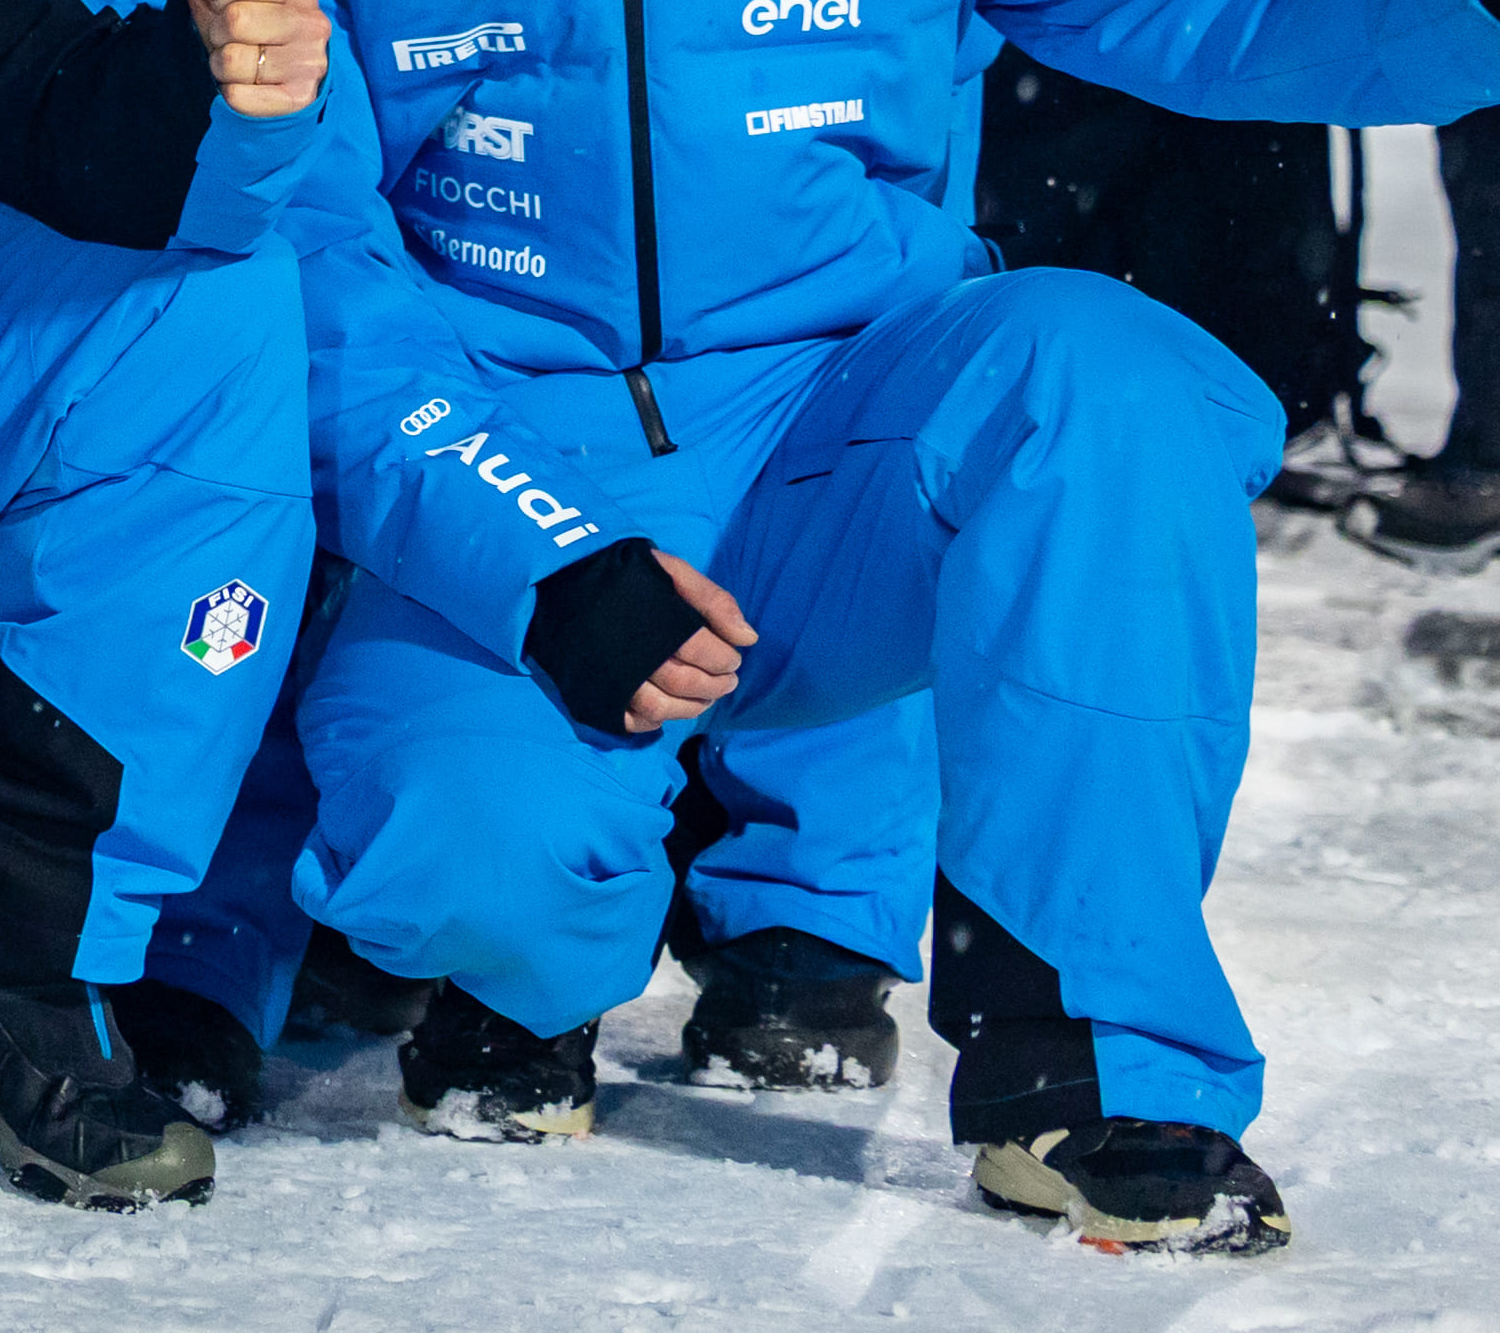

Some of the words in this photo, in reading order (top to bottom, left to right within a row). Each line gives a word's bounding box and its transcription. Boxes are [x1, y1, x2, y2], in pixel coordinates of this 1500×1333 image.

[392, 22, 527, 71] PIRELLI
[769, 99, 864, 132] FINSTRAL
[414, 169, 542, 219] FIOCCHI
[425, 432, 599, 549] Audi
[208, 579, 253, 608] FISI
